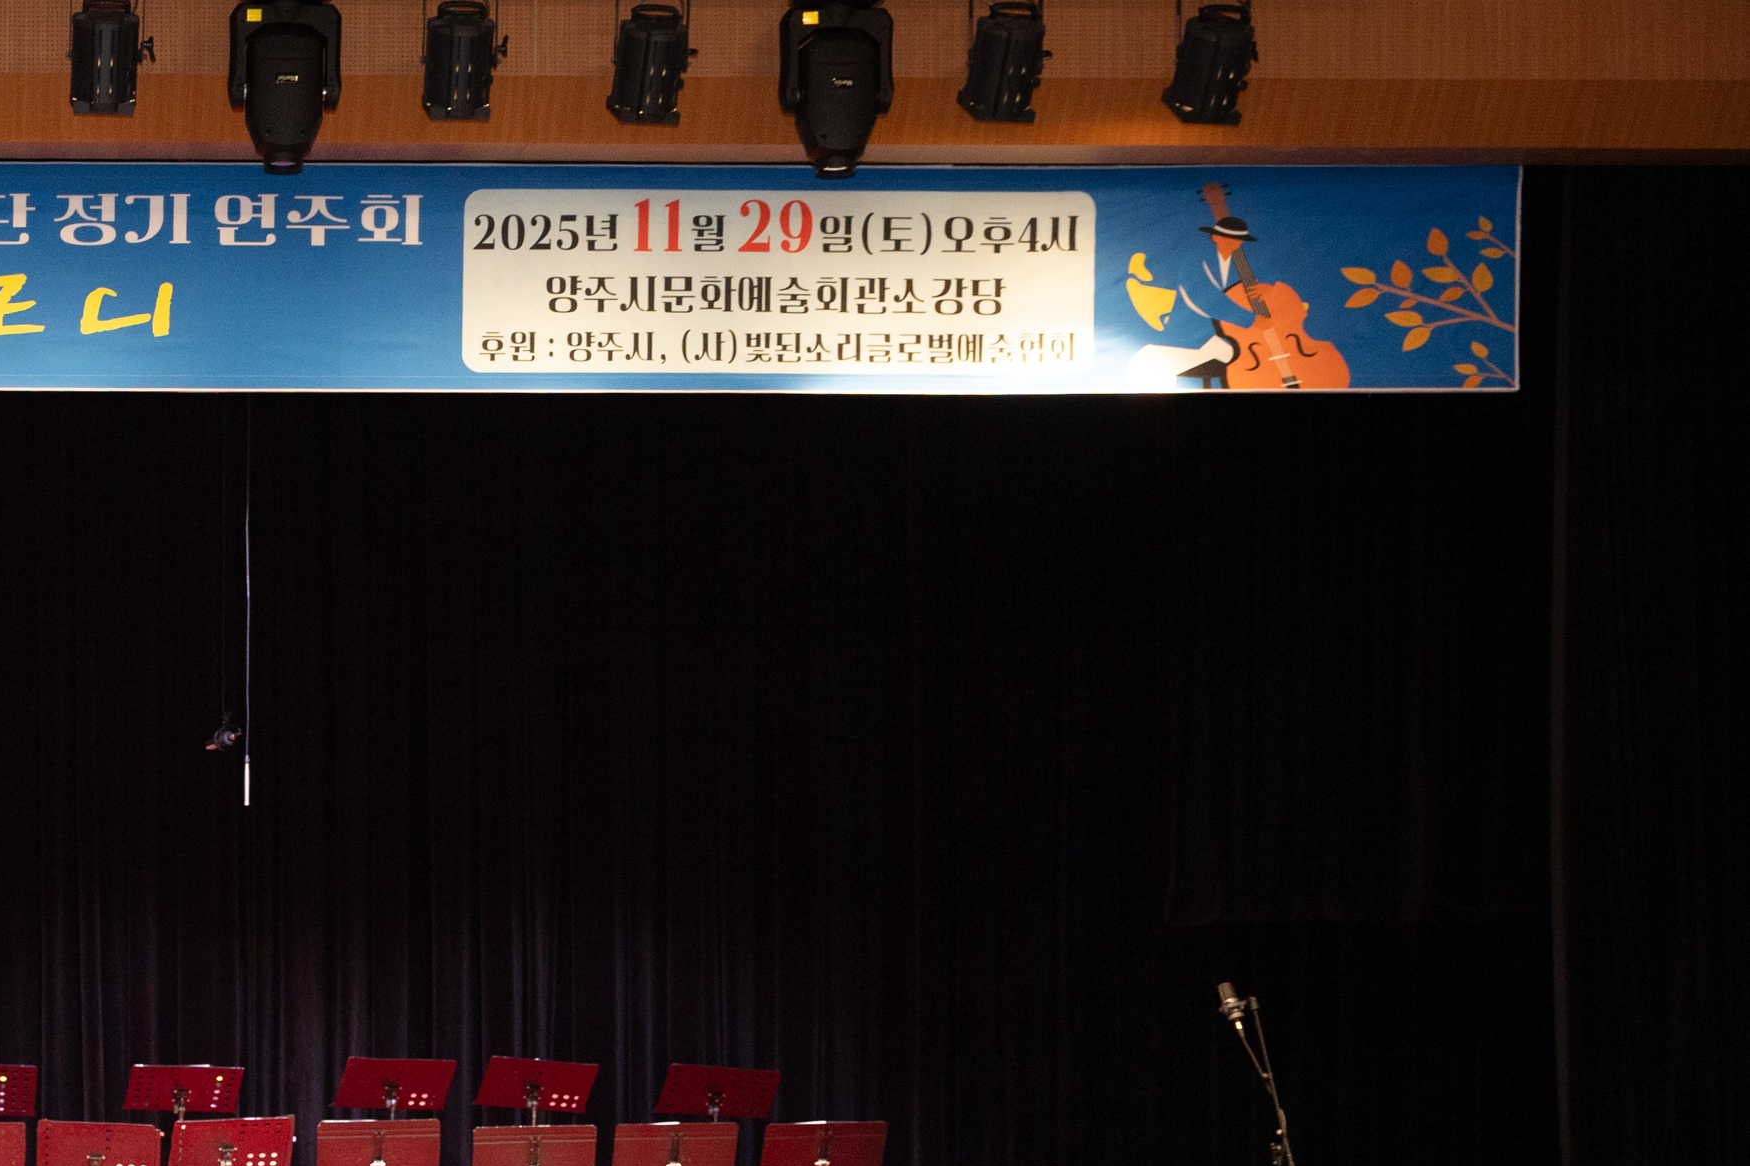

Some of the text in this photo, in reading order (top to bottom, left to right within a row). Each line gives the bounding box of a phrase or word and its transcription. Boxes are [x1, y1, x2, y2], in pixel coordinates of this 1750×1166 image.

[54, 194, 190, 245] 정기
[215, 194, 422, 246] 연주회
[473, 214, 619, 253] 2025년
[546, 274, 1007, 315] 양주시문화예술회관소강당
[566, 330, 666, 365] 양주시,
